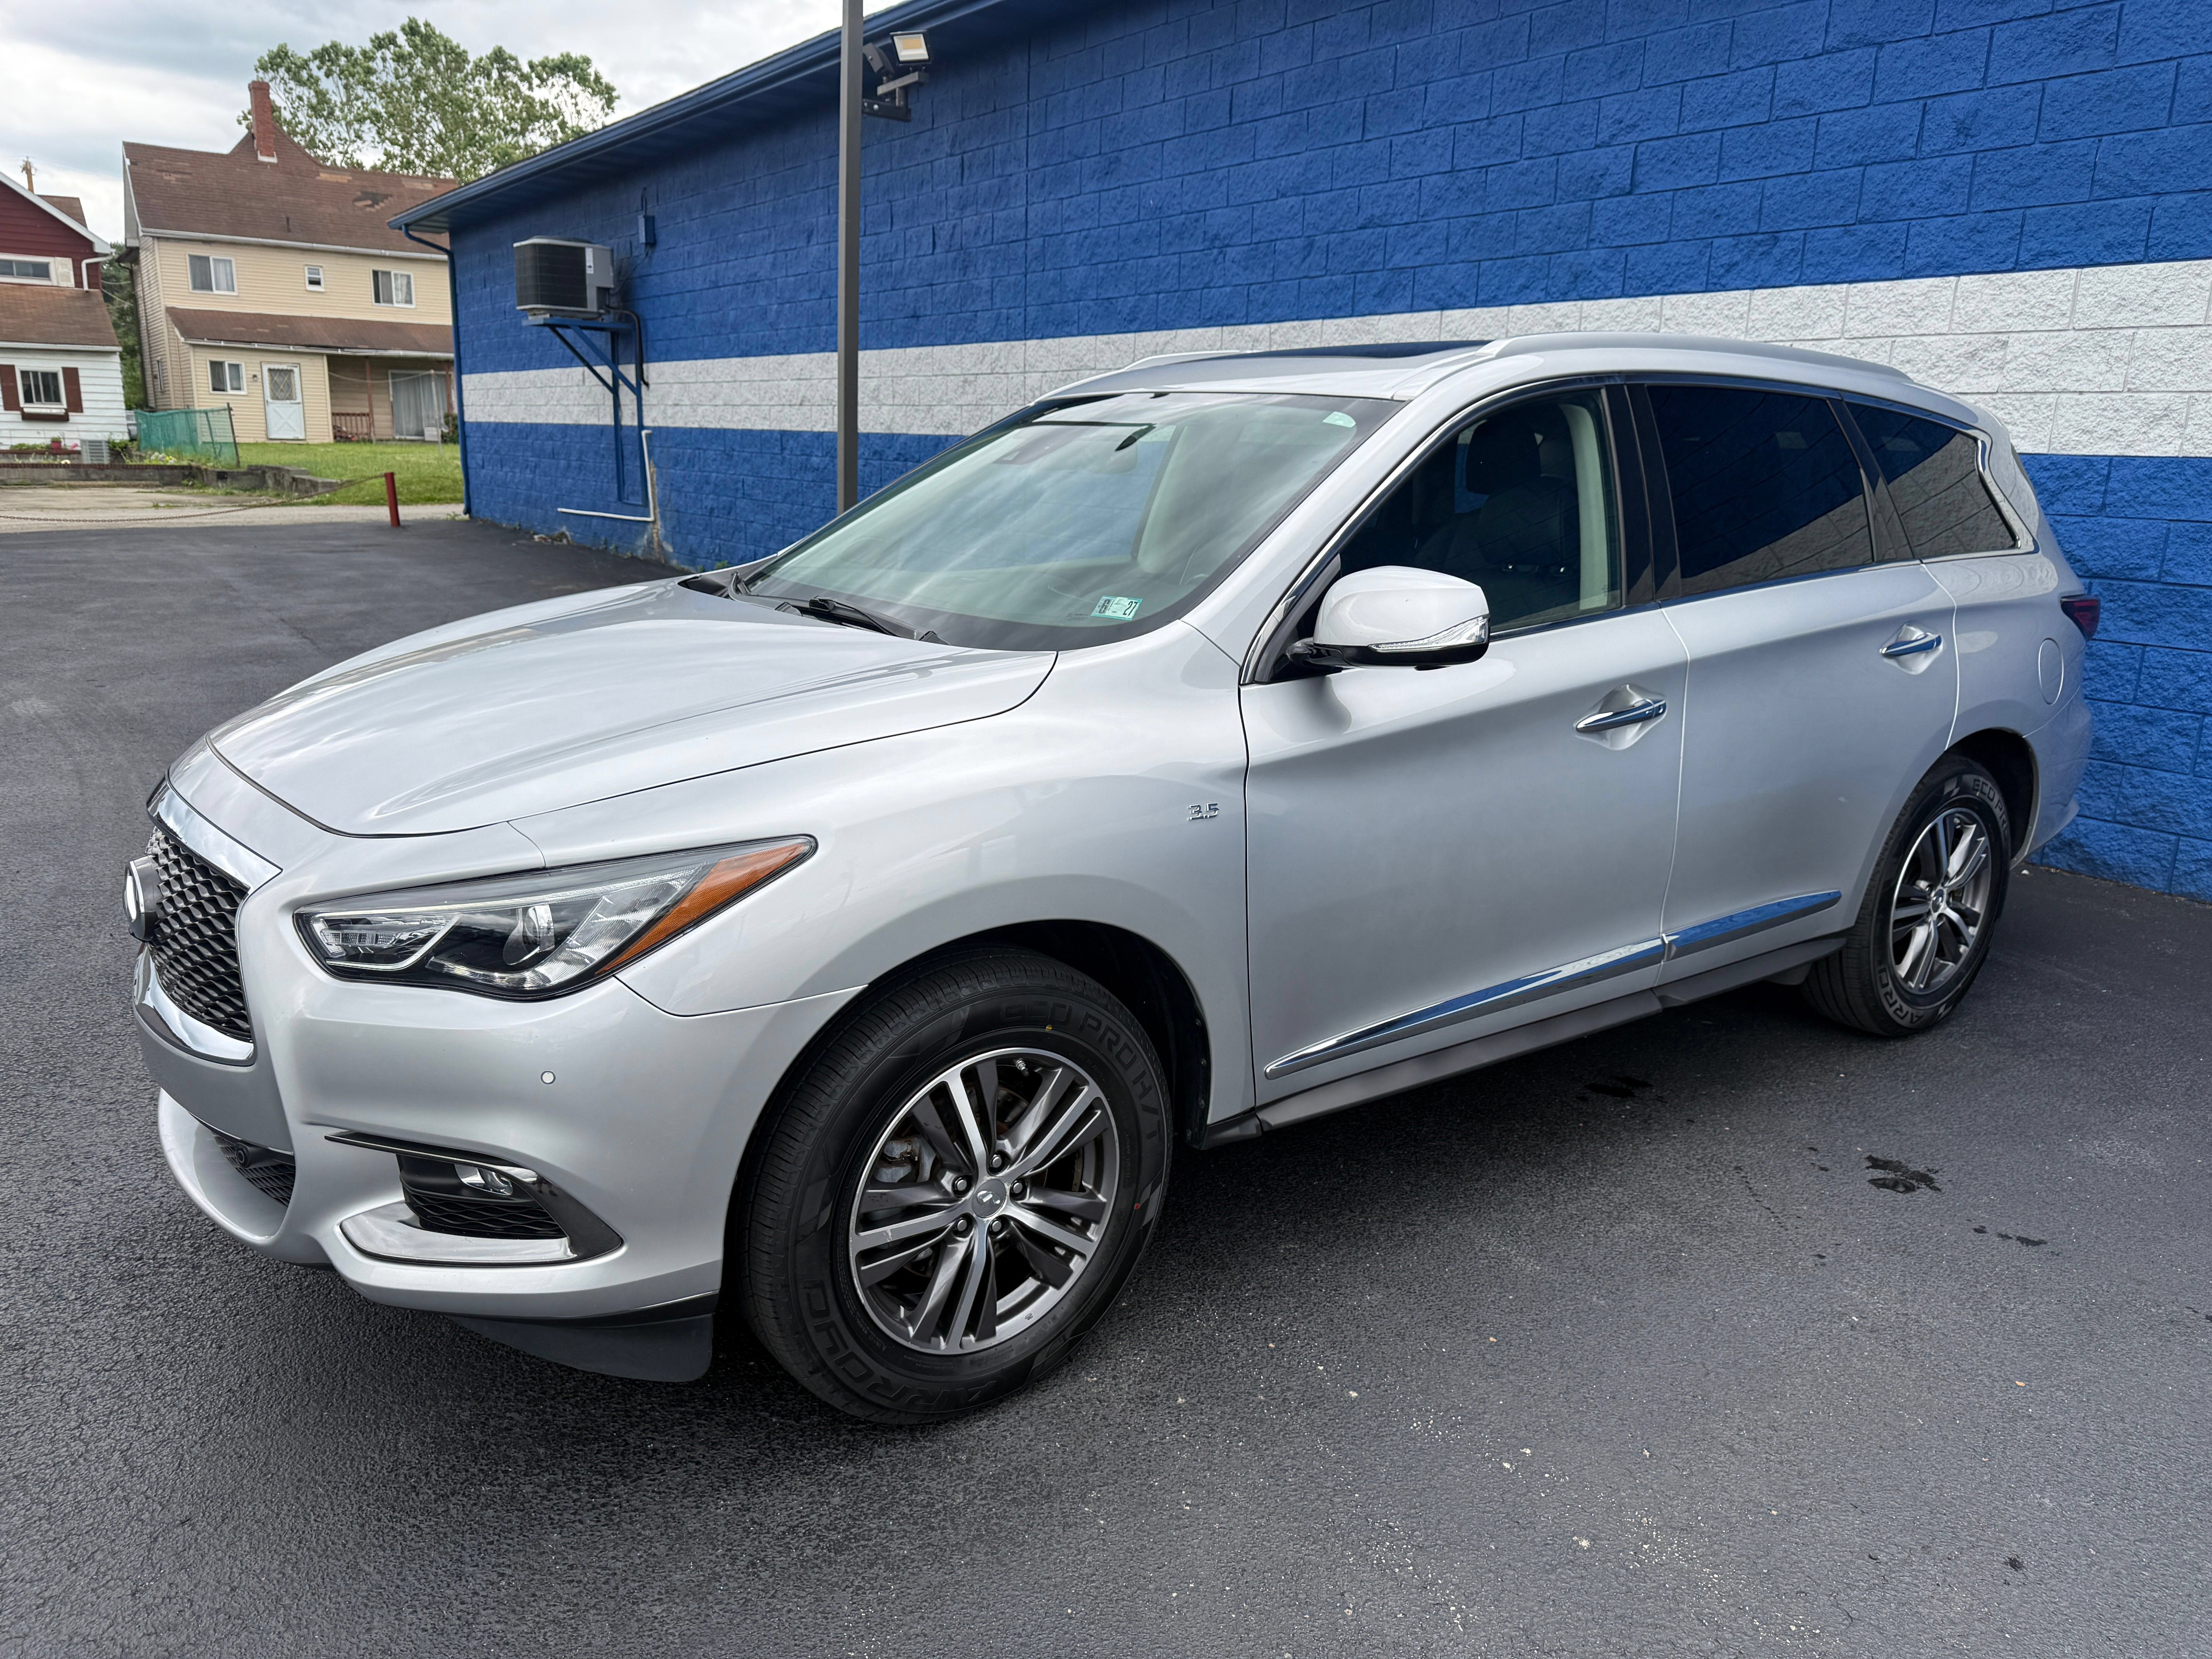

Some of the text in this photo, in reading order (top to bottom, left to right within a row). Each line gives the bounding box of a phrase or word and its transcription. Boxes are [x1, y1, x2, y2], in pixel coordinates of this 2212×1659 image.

[1098, 599, 1111, 614] 6
[1122, 601, 1139, 617] 27
[1973, 778, 1996, 802] ECO
[1188, 802, 1220, 820] 3.5
[1004, 1001, 1072, 1025] ECO
[1079, 1012, 1137, 1070] PRO
[803, 1279, 997, 1405] ARROYO
